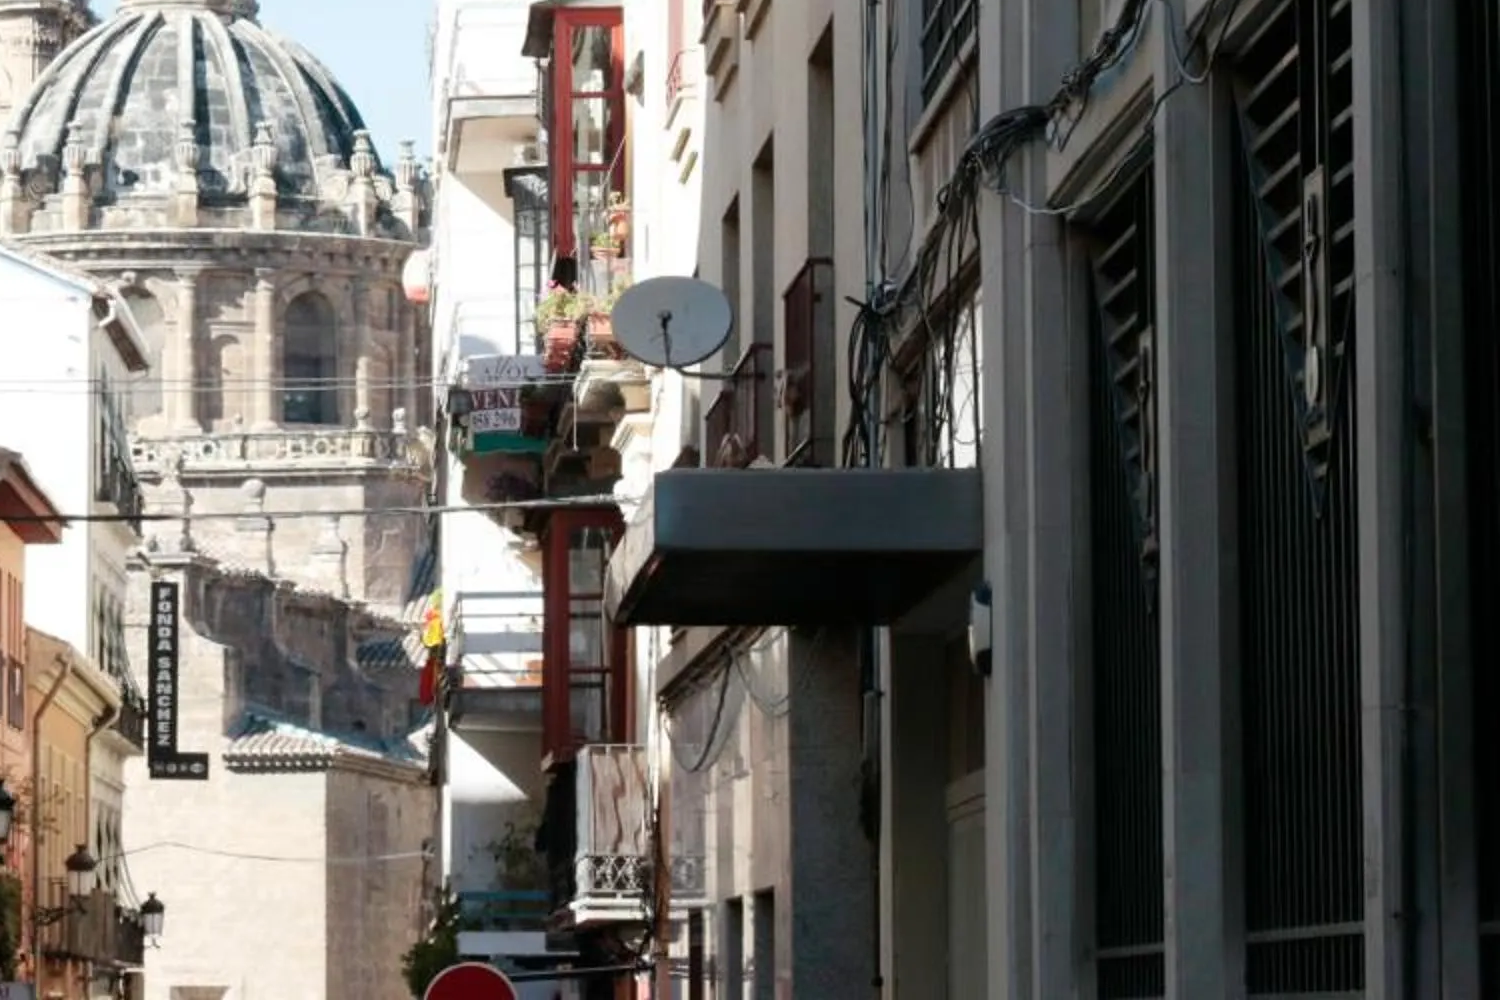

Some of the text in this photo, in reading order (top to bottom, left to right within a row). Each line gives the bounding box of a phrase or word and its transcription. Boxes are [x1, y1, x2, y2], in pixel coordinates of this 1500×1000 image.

[471, 388, 519, 409] VEN
[156, 586, 173, 746] FONDA SANCHEZ
